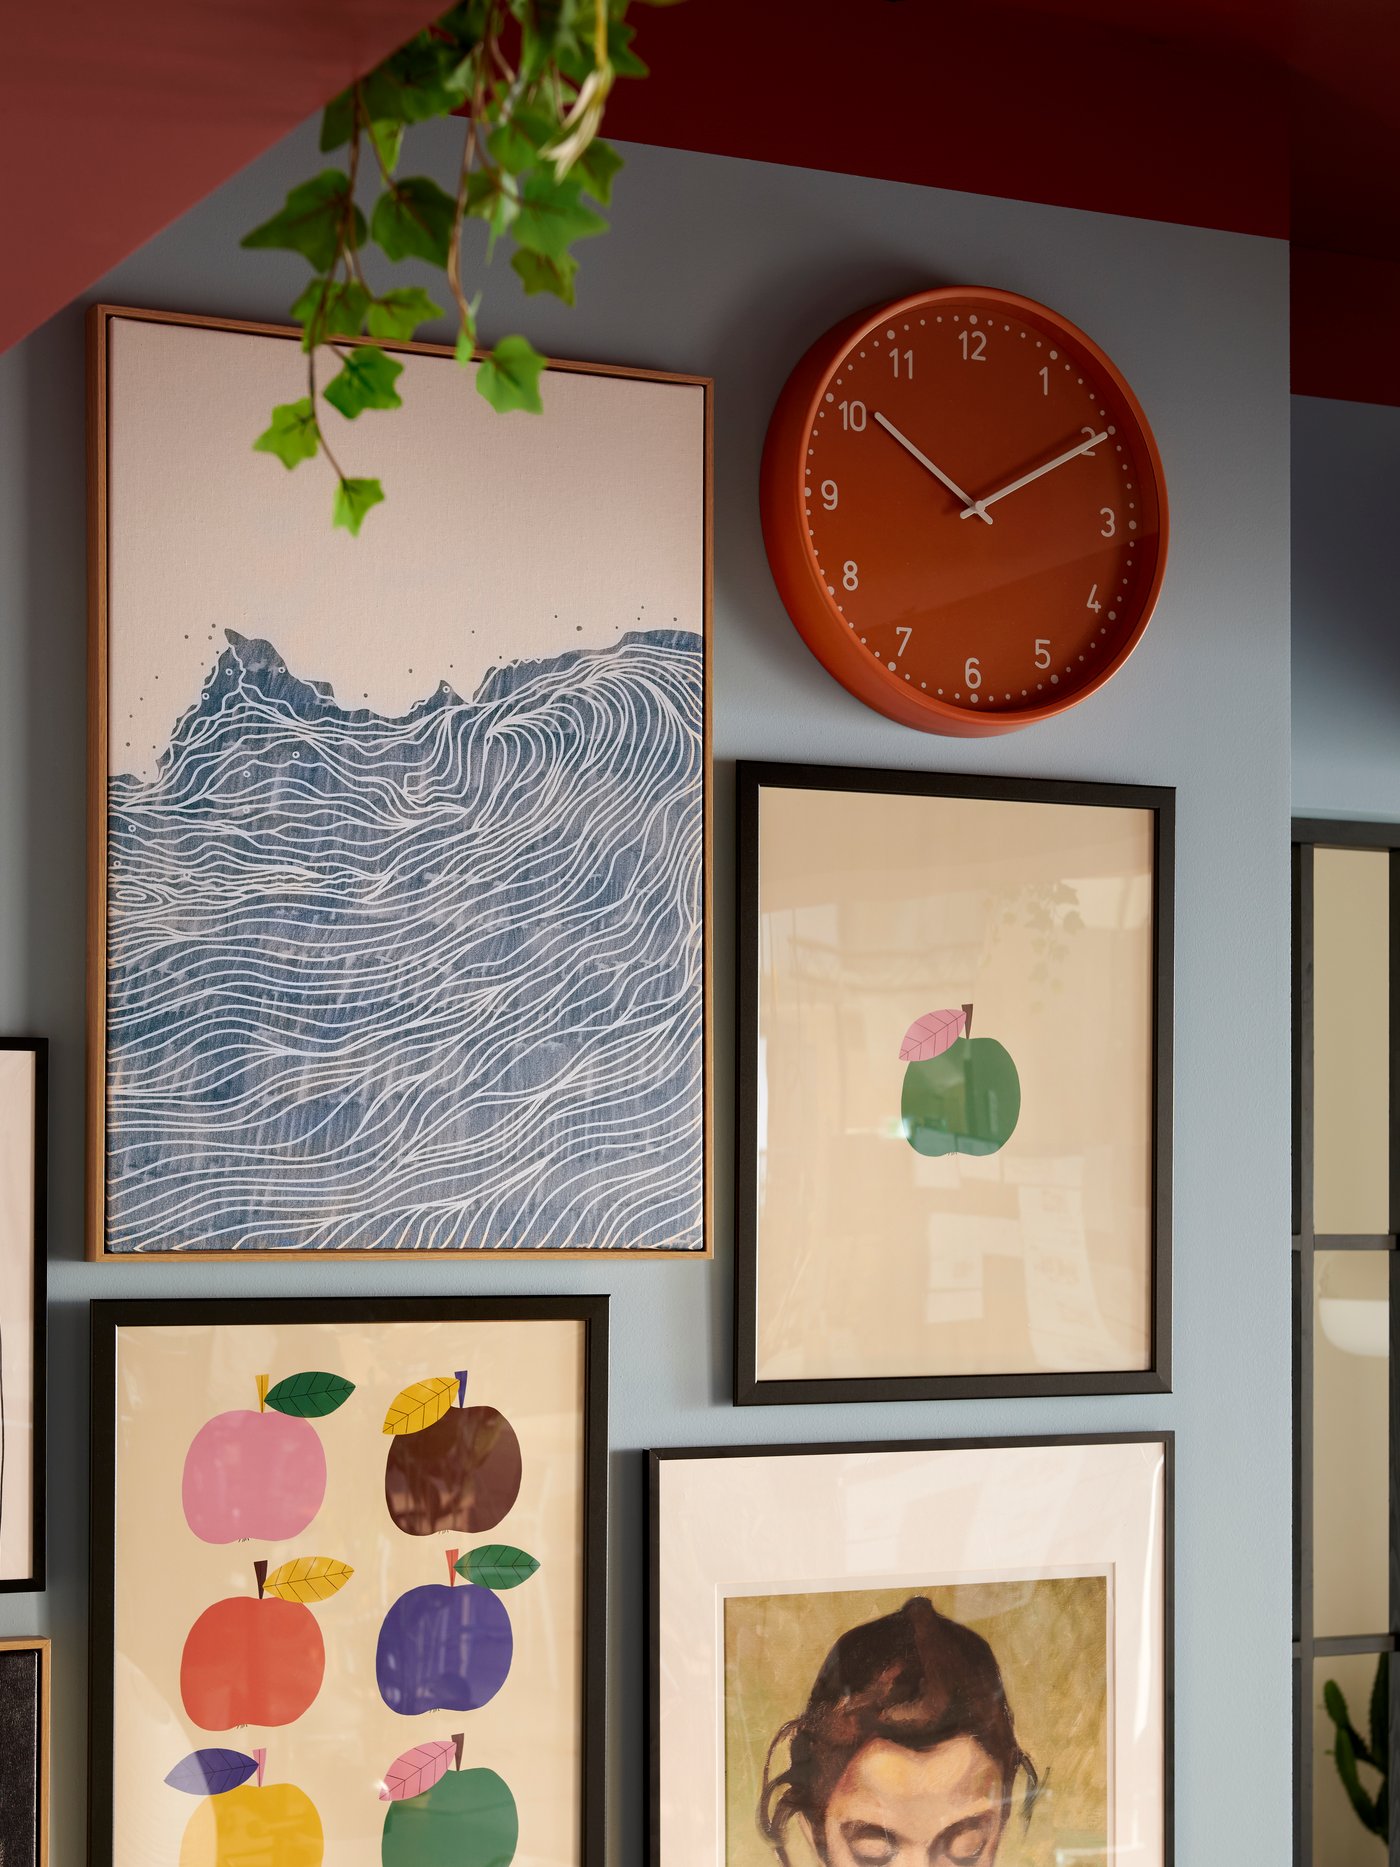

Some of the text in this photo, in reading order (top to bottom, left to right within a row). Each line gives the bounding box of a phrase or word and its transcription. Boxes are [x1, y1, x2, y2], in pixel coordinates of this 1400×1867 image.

[958, 330, 987, 362] 12
[888, 347, 913, 380] 11
[1038, 366, 1049, 396] 1
[838, 400, 867, 432] 10
[820, 479, 839, 511] 9
[1099, 507, 1116, 538] 3
[842, 560, 859, 592] 8
[1086, 583, 1102, 614] 4
[895, 626, 913, 657] 7
[1034, 638, 1051, 670] 5
[964, 657, 982, 689] 6
